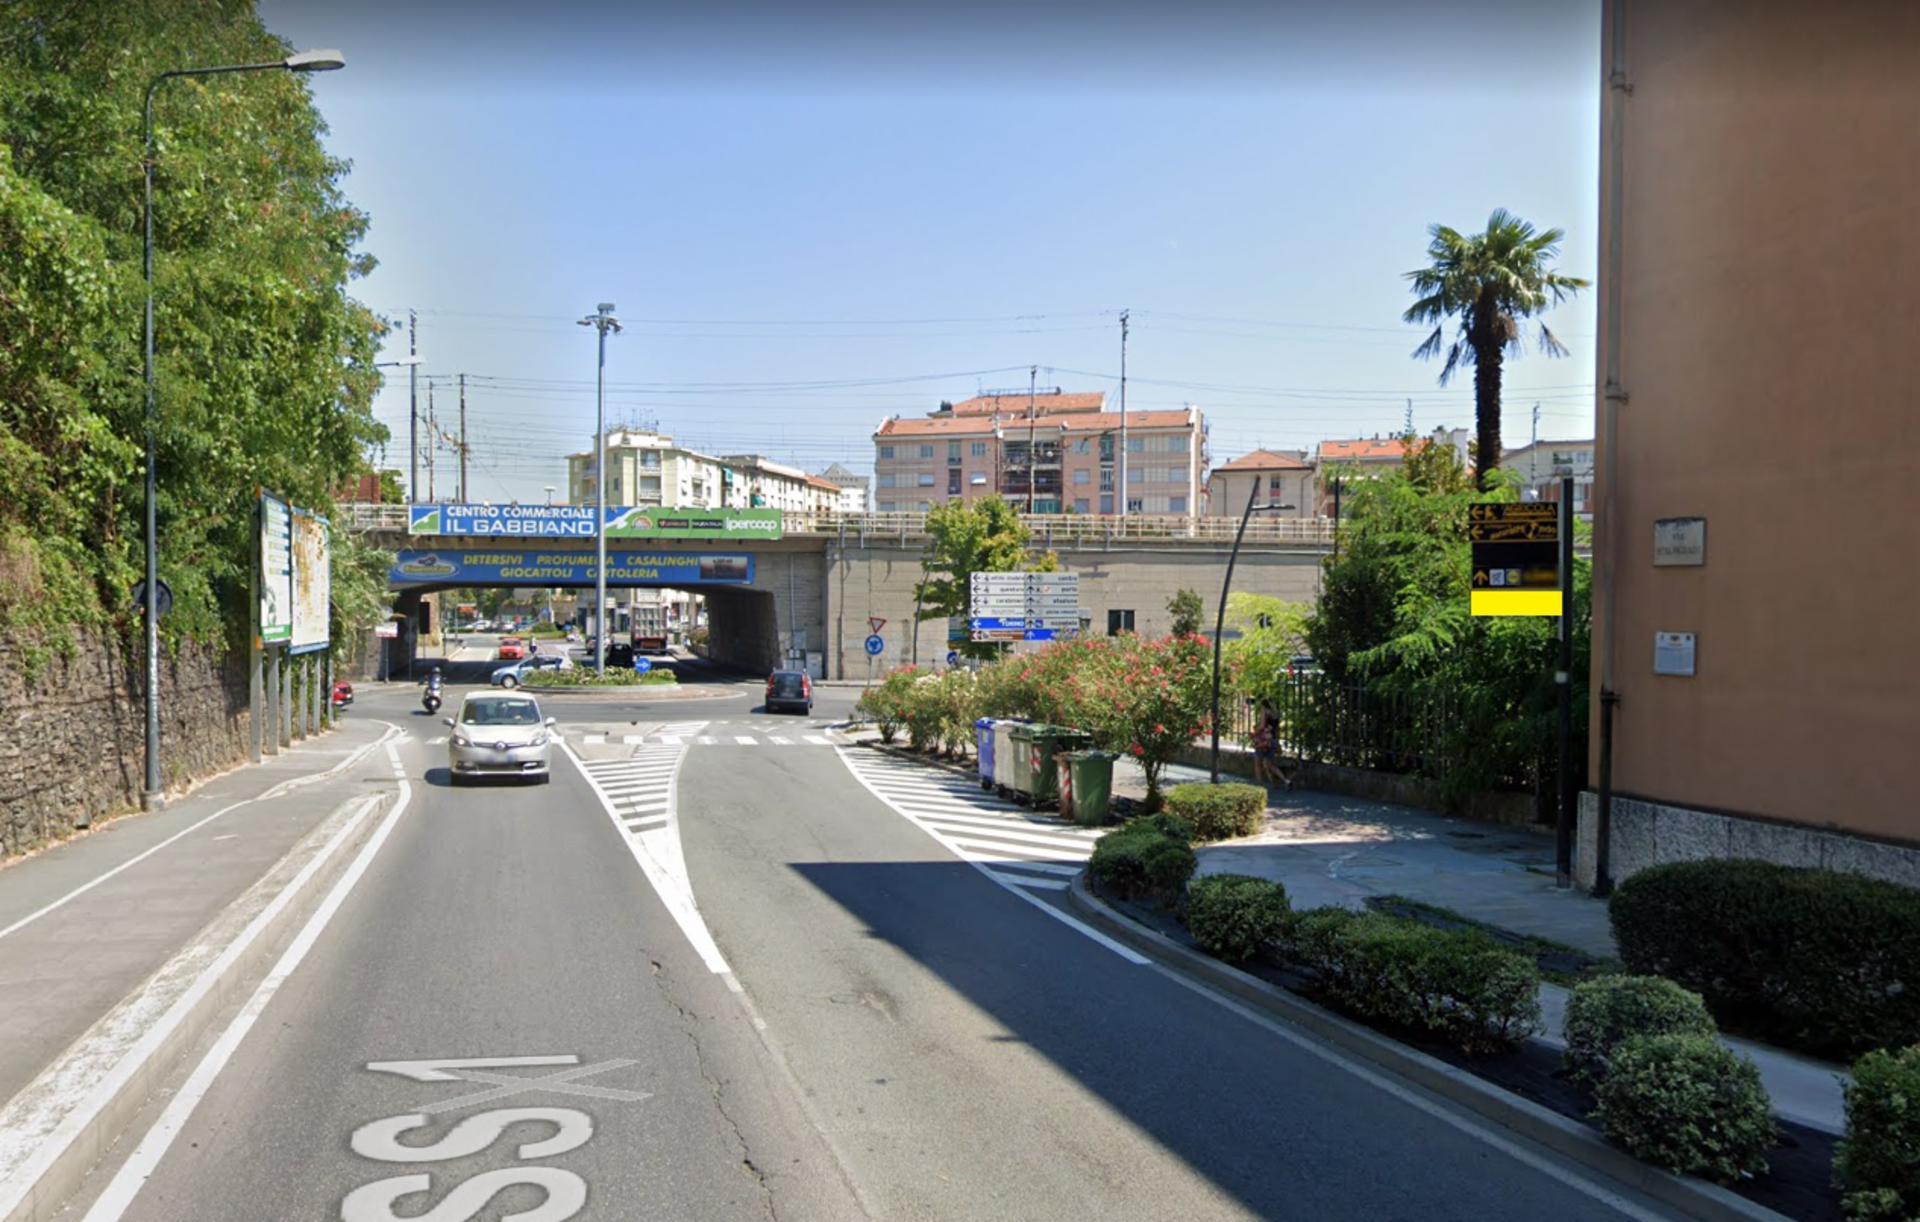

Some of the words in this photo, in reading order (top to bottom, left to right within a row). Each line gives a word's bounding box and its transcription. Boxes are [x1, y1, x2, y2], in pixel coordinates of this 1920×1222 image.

[446, 506, 499, 518] CENTRO
[503, 506, 595, 519] COMMERCIALE
[446, 519, 467, 533] IL
[473, 519, 595, 535] GABBIANO
[726, 517, 777, 532] ipercoop
[463, 555, 523, 565] DETERSIVI
[626, 556, 699, 567] CASALINGHI
[500, 567, 573, 578] GIOCATTOLI
